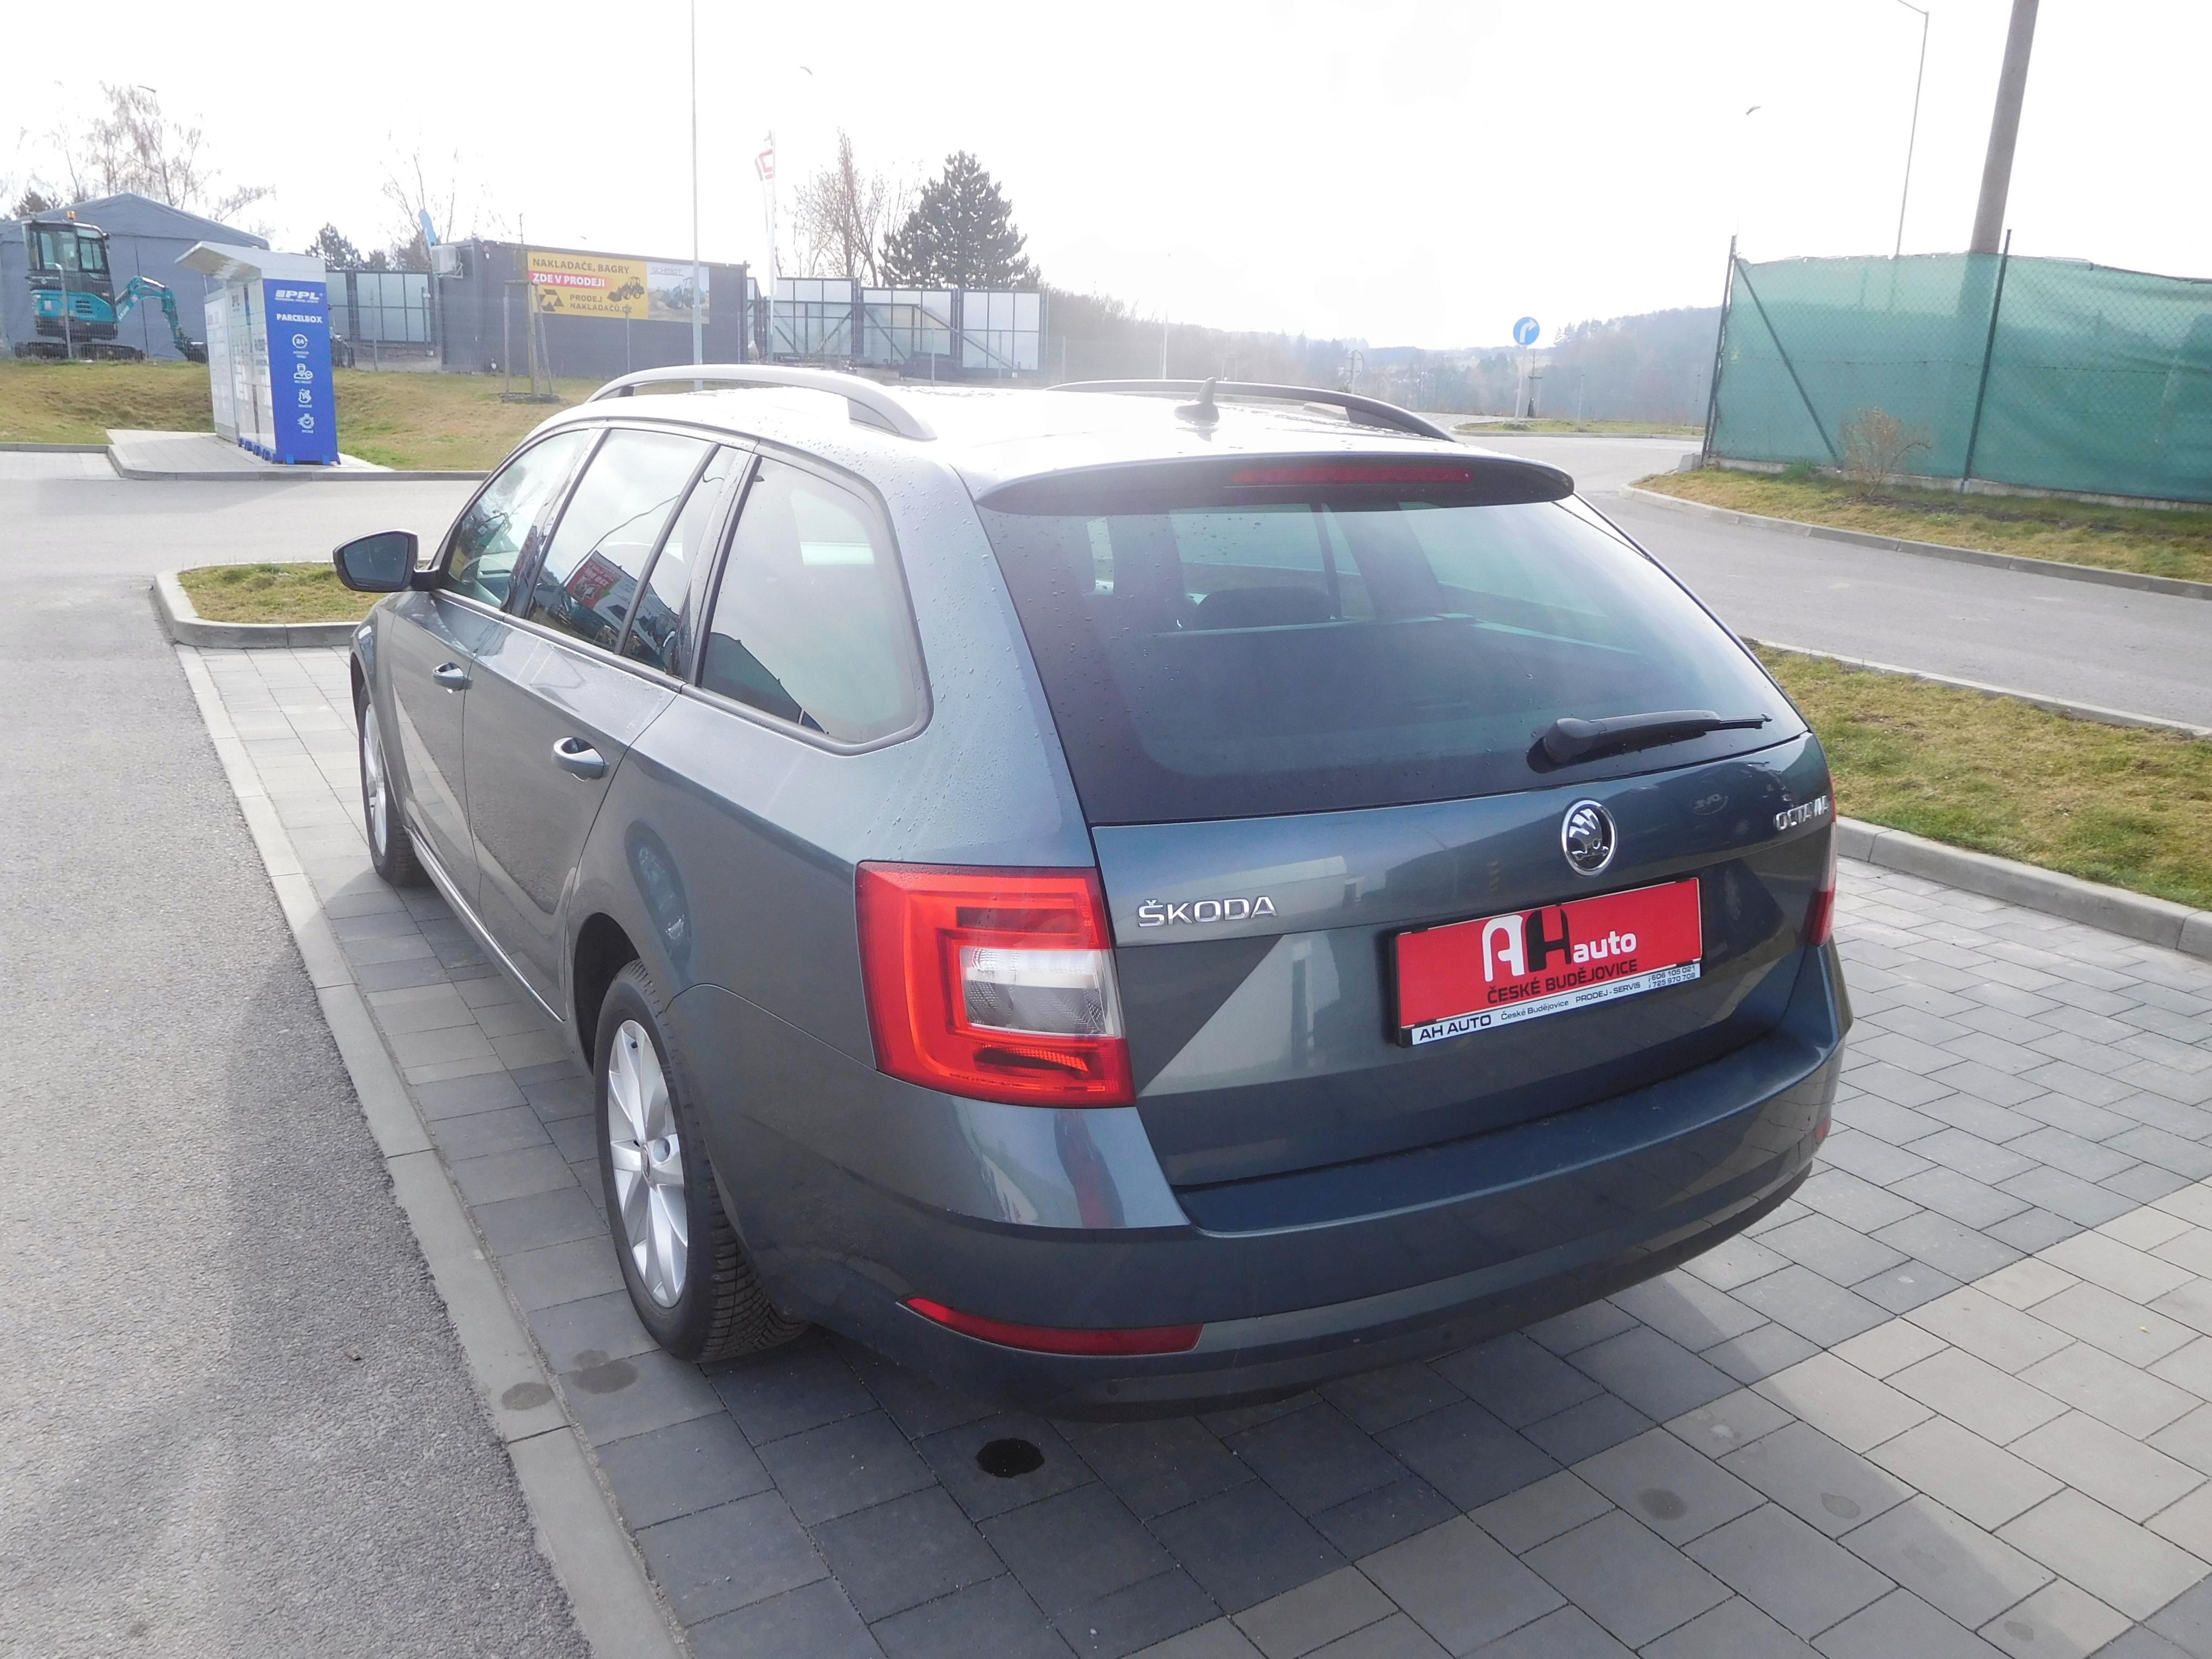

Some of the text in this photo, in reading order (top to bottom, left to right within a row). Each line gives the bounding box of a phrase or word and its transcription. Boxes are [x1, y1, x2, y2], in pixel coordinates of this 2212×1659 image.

[533, 258, 630, 274] NAKLADAČE, BAGRY
[533, 273, 605, 287] ZDE V PRODEJI
[285, 290, 320, 300] PPL
[570, 294, 603, 303] PRODEJ
[276, 313, 322, 323] PARCELBOX
[1138, 895, 1278, 928] ŠKODA
[1487, 959, 1638, 1004] ČESKÉ BUDĚJOVICE
[1653, 979, 1666, 988] 725
[1668, 975, 1681, 984] 970
[1419, 1025, 1444, 1041] AH
[1447, 1014, 1492, 1035] AUTO
[1501, 1011, 1526, 1020] České
[1527, 1000, 1569, 1015] Budějovice
[1575, 989, 1608, 1003] PRODEJ
[1613, 982, 1641, 994] SERVIS
